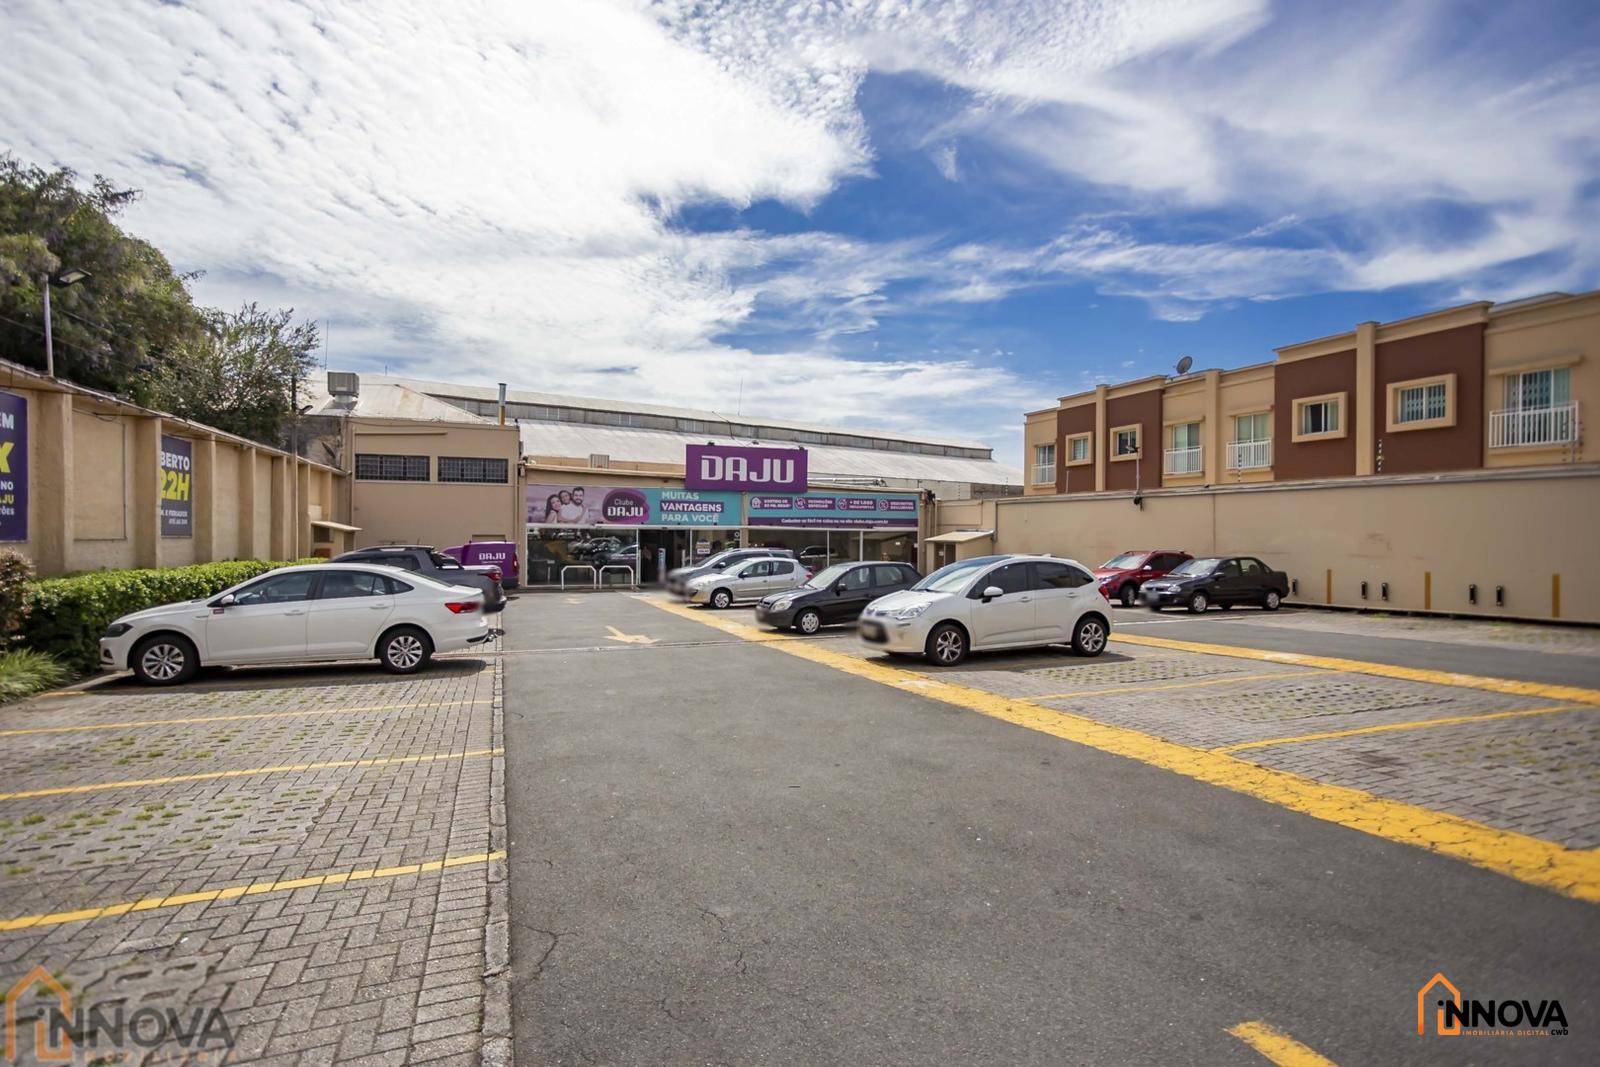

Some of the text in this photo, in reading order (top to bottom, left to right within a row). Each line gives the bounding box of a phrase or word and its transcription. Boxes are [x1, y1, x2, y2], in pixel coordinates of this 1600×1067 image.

[701, 455, 794, 483] DAJU
[0, 494, 14, 505] JU
[662, 491, 700, 500] MUITAS
[607, 506, 644, 516] DAJU
[661, 502, 722, 512] VANTAGENS
[662, 513, 718, 523] PARA VOCÊ
